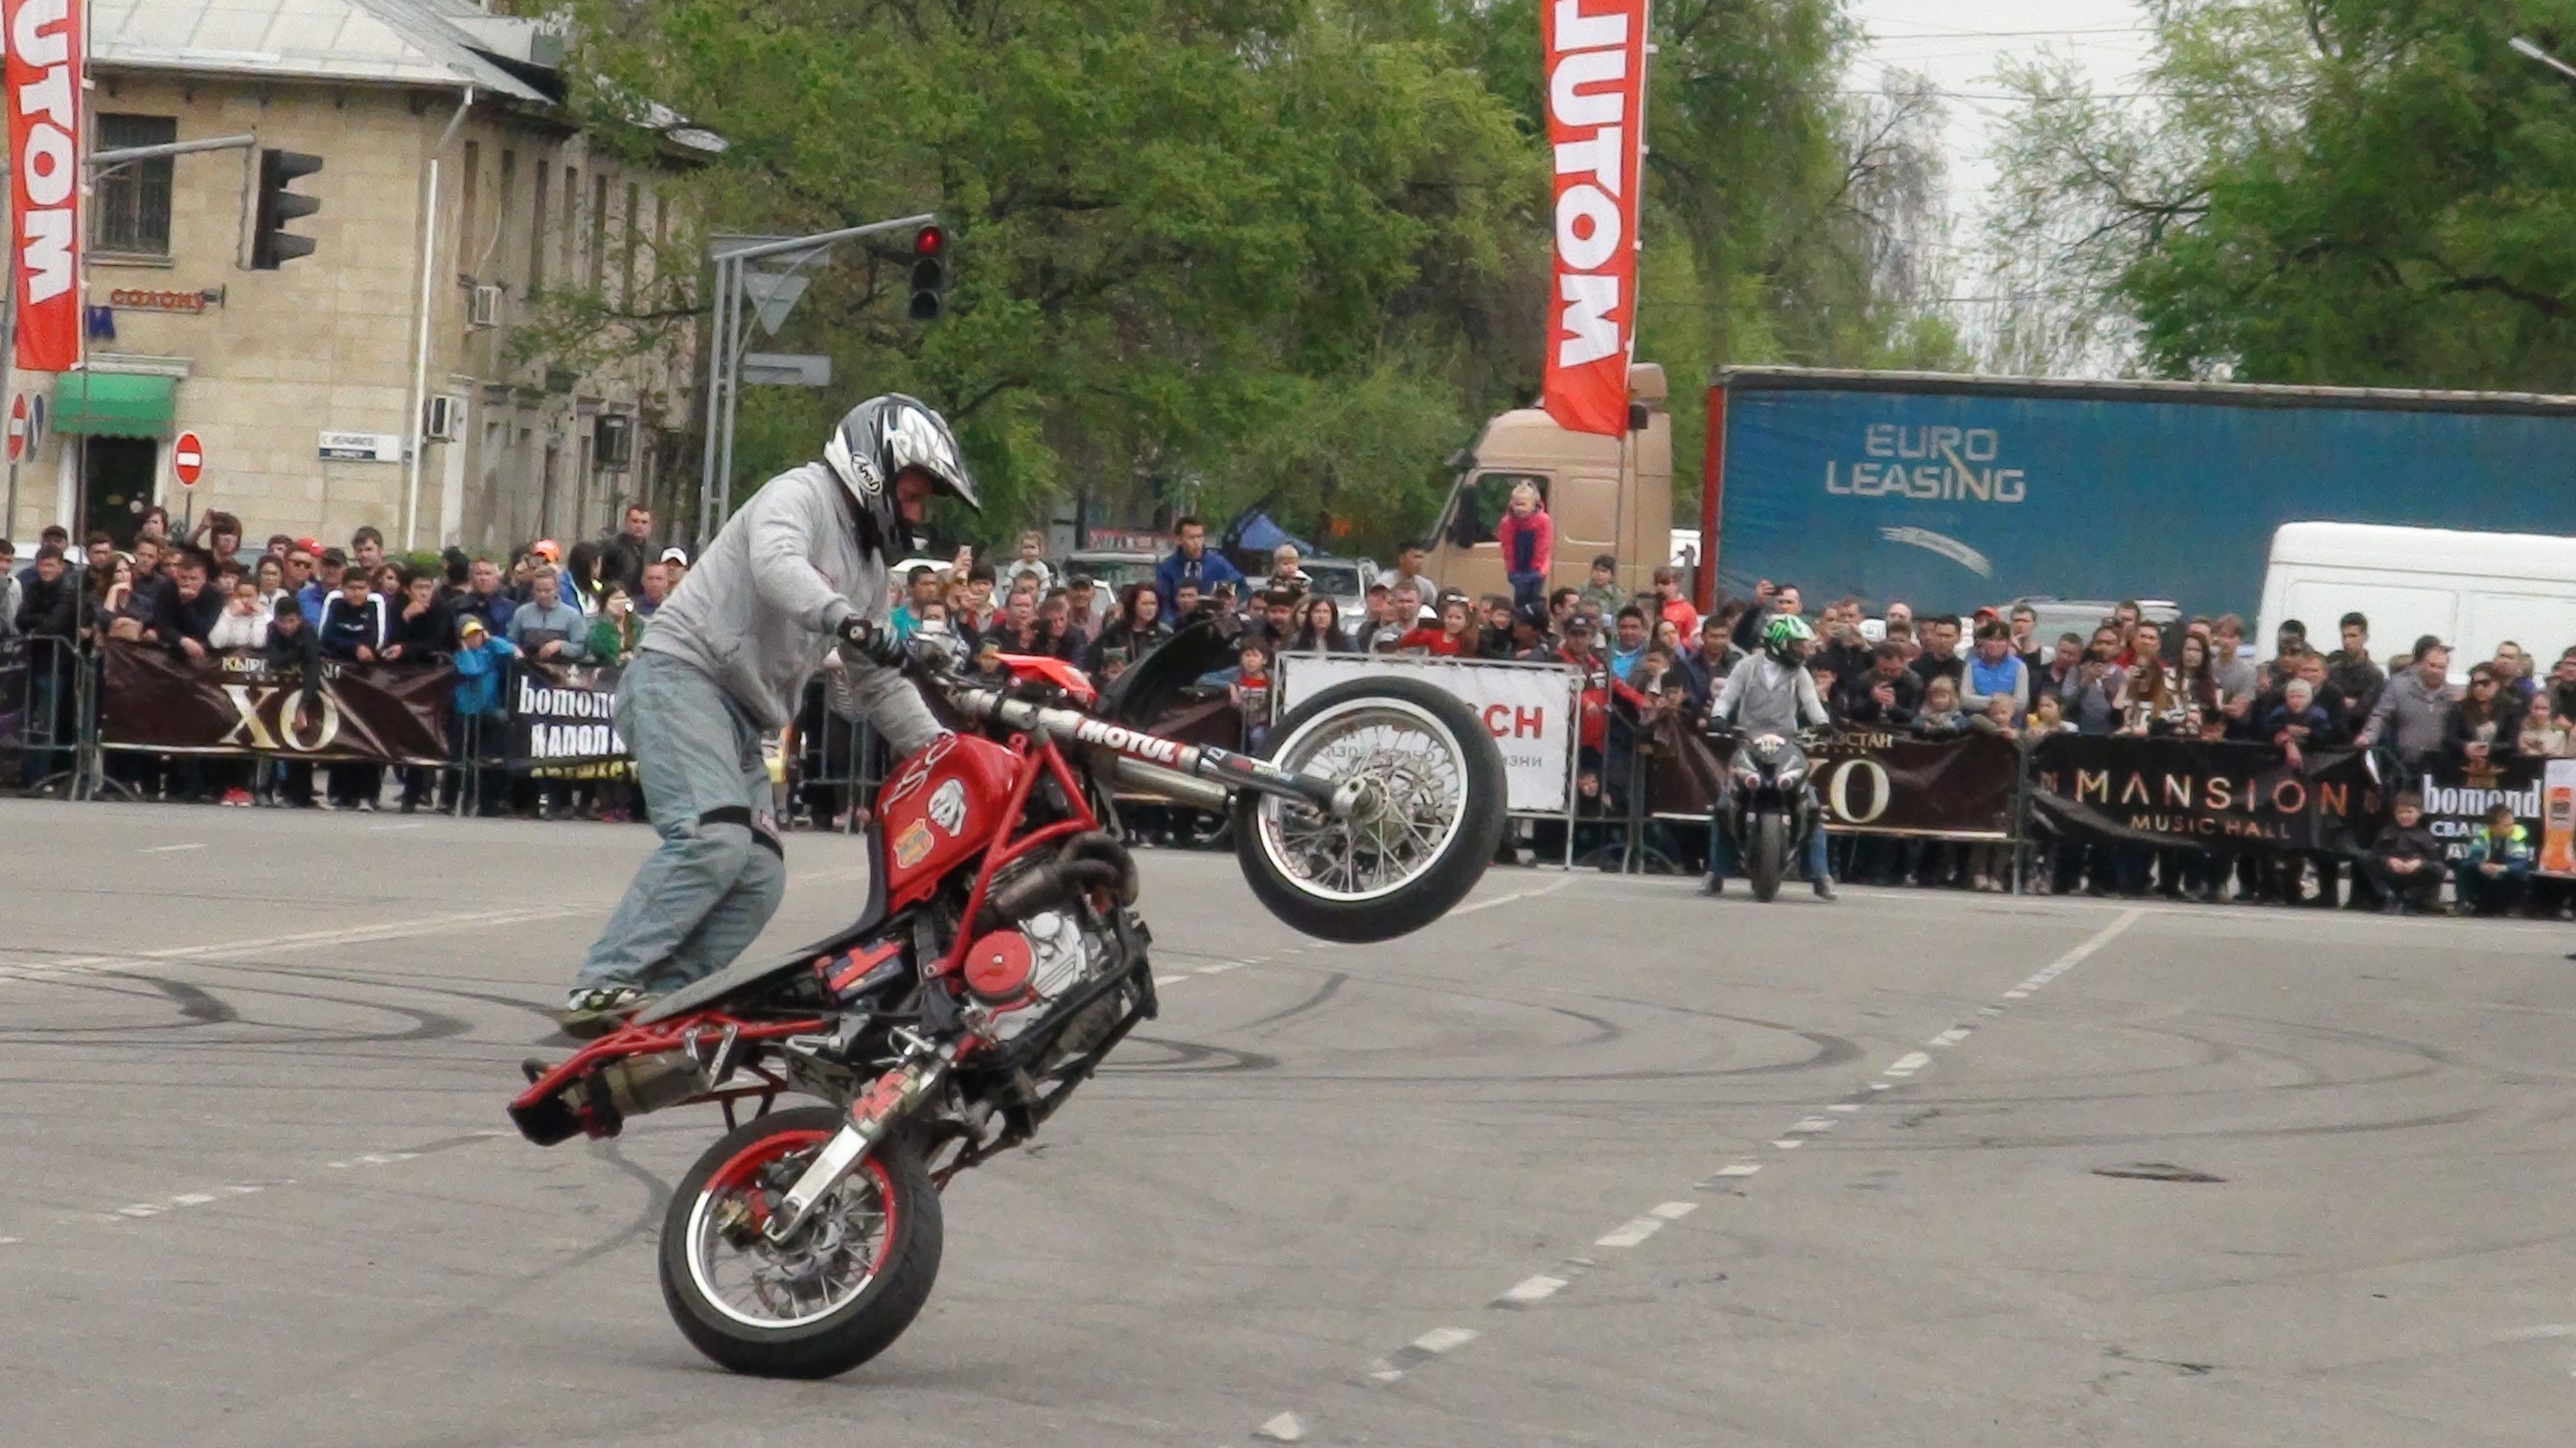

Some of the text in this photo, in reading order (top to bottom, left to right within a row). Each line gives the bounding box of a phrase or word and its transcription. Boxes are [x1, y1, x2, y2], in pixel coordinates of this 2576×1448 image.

[1866, 423, 1998, 462] EURO
[1828, 461, 2026, 503] LEASING
[1077, 719, 1178, 764] MOTUL
[2075, 768, 2348, 816] MANSION
[2423, 773, 2542, 817] bomond
[2129, 814, 2291, 840] MUSIC HALL
